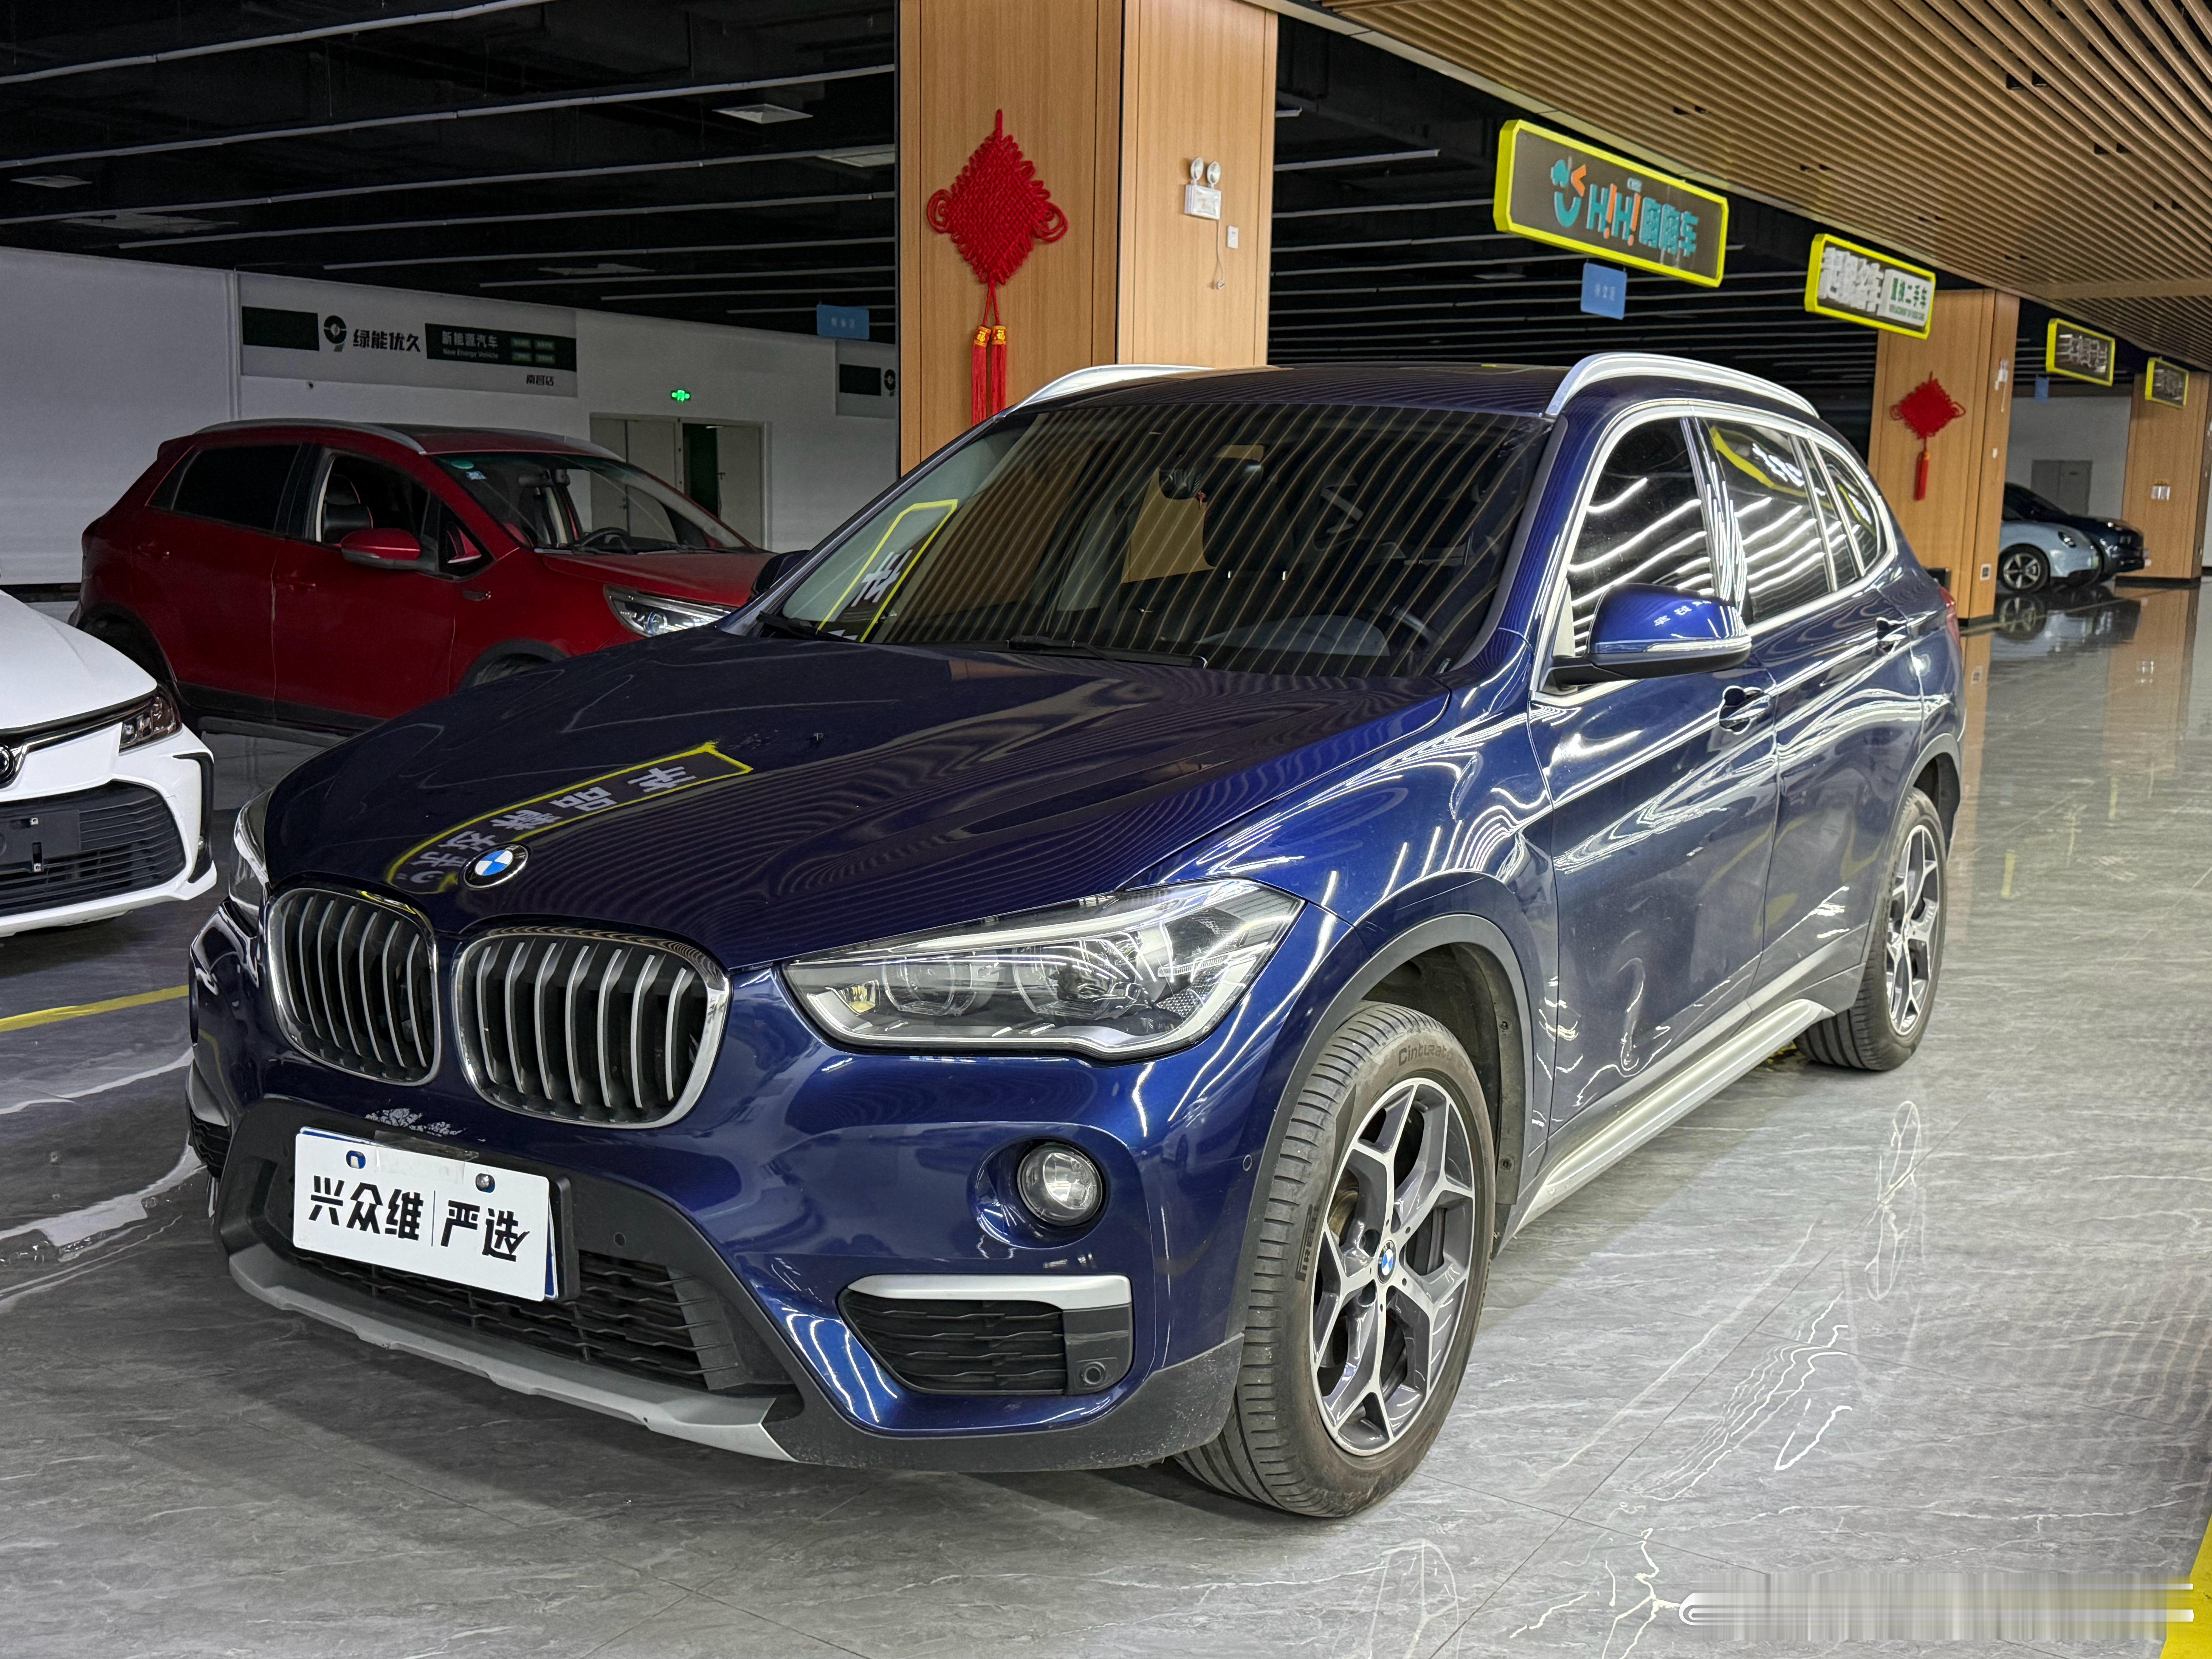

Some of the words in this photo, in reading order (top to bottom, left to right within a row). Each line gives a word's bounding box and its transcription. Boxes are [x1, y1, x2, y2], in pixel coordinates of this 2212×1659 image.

[353, 329, 421, 352] 绿能优久
[1398, 1043, 1453, 1066] Cinturato
[308, 1175, 424, 1241] 兴众维
[441, 1200, 530, 1262] 严选
[1295, 1204, 1319, 1282] PIRELLI
